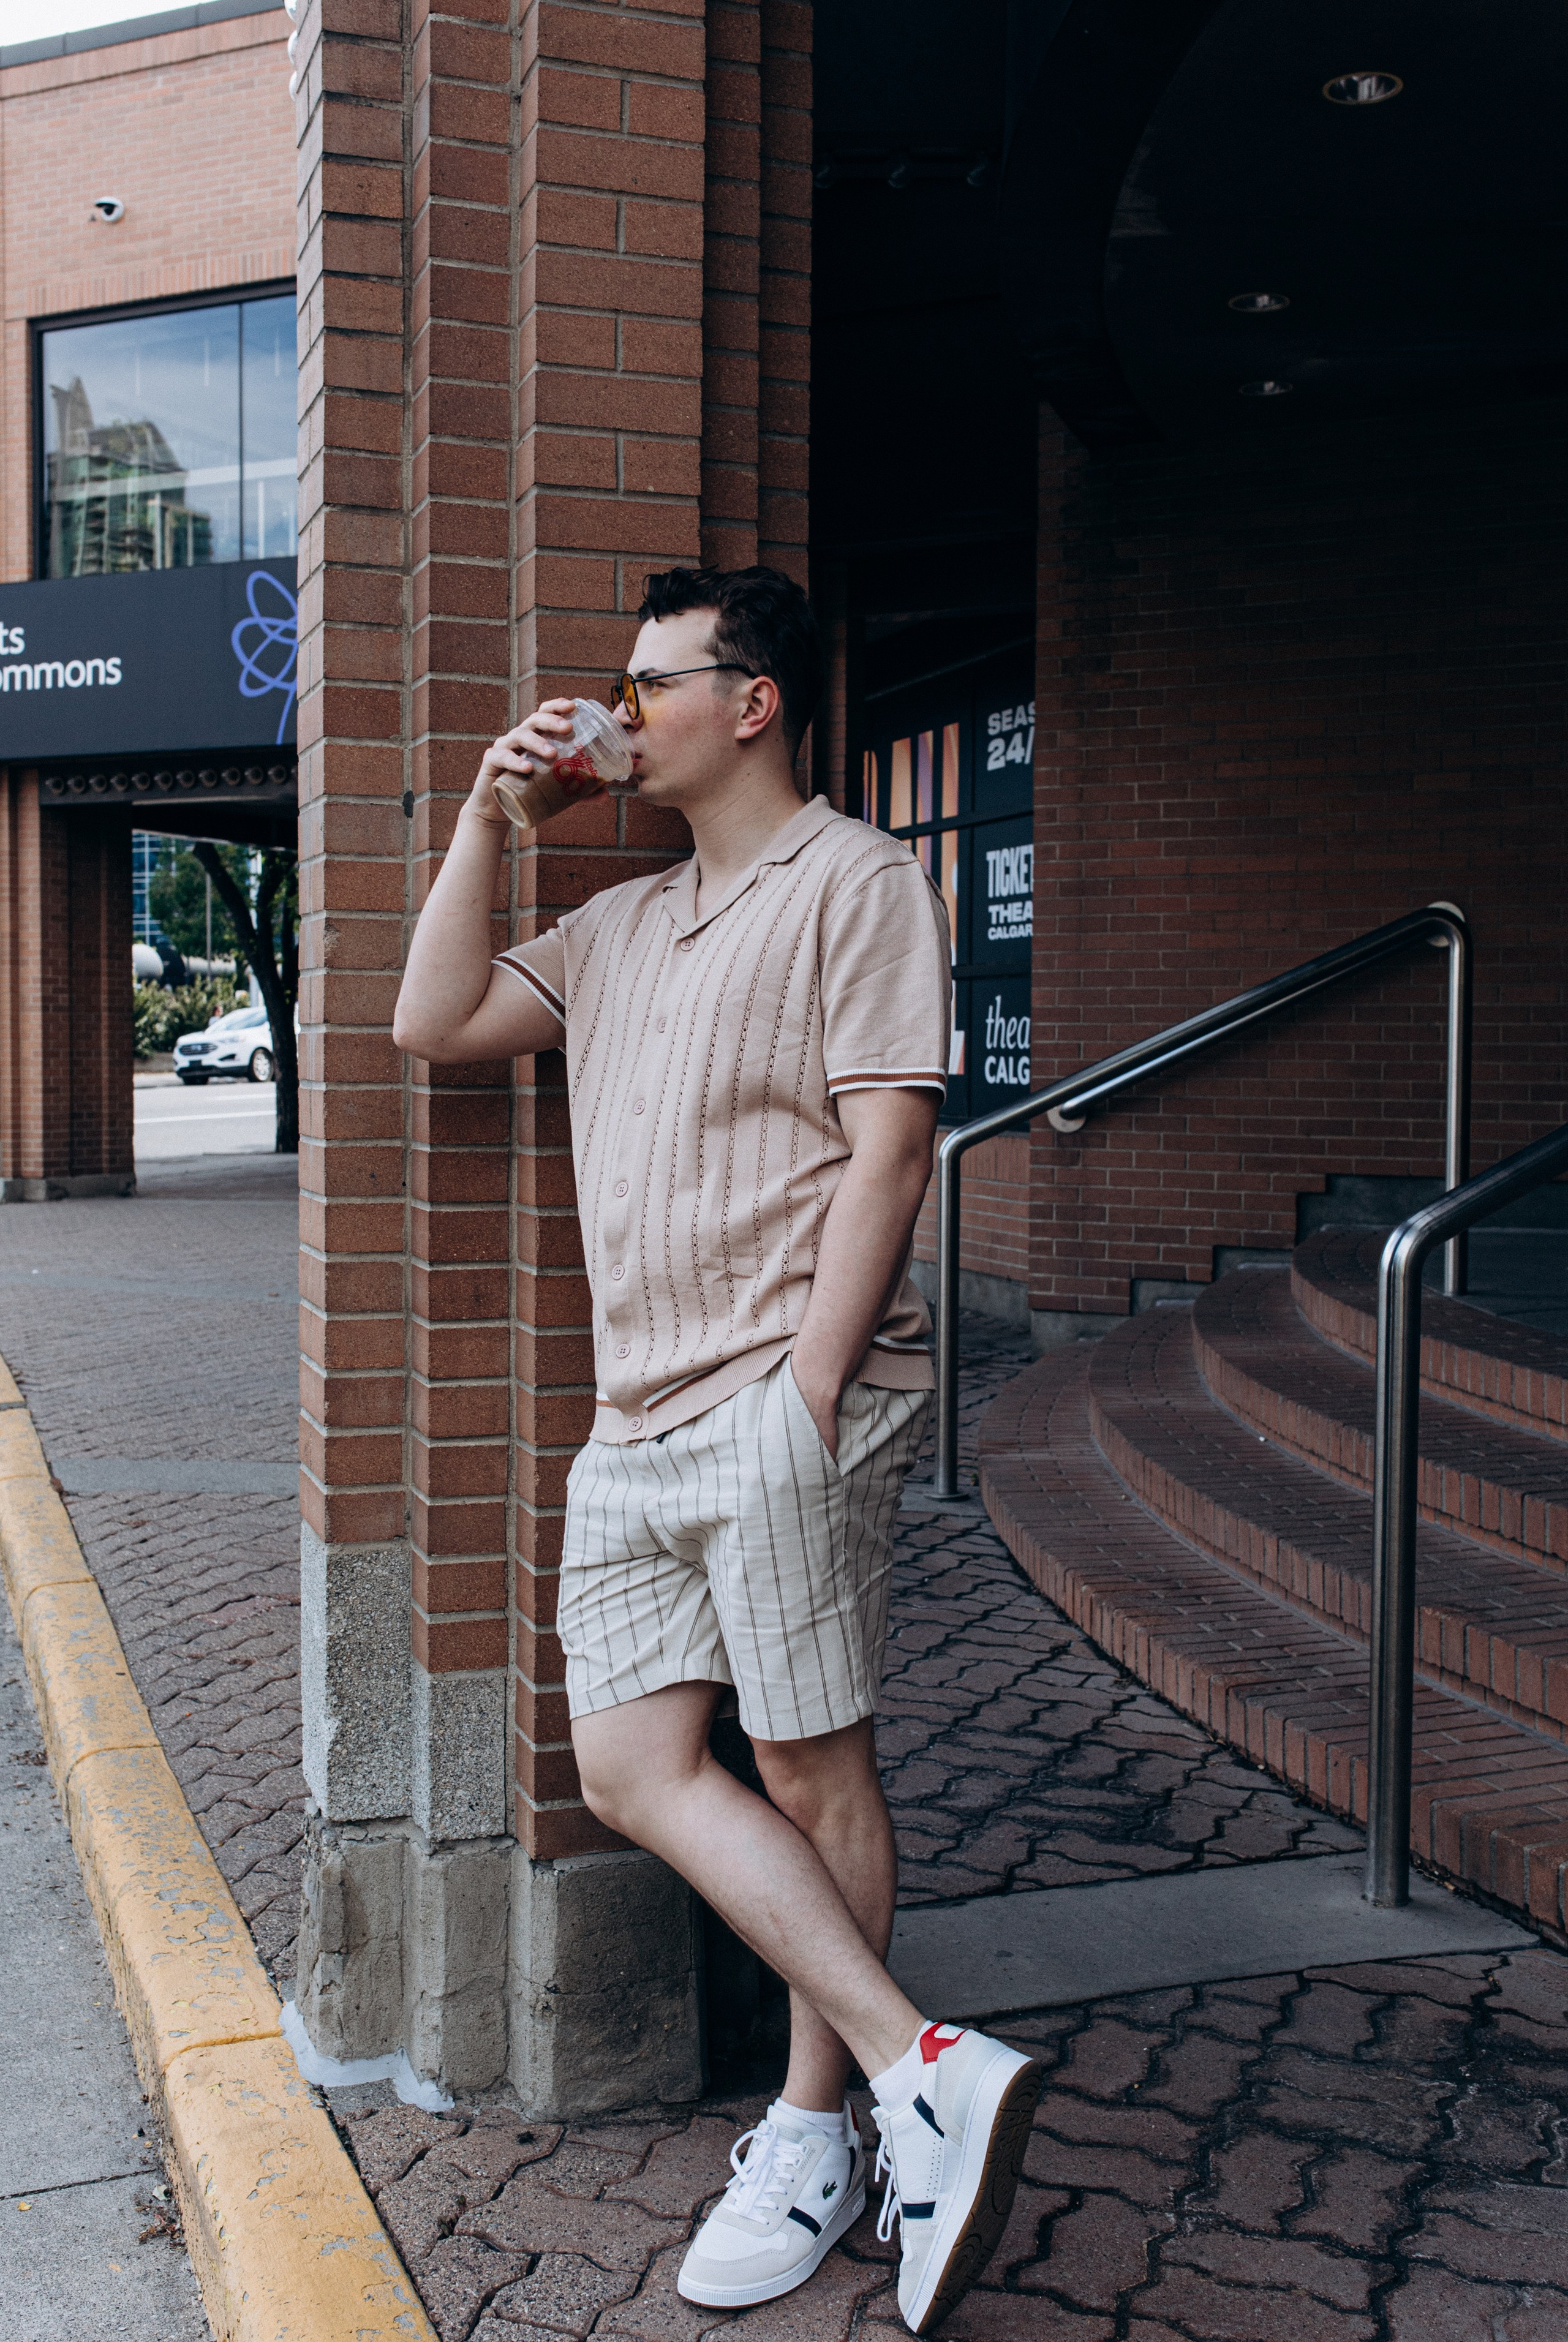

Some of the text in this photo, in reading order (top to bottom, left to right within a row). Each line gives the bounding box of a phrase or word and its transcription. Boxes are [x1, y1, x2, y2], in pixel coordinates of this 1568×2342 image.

[0, 657, 123, 693] mmons
[985, 994, 1031, 1049] thea
[984, 1055, 1030, 1086] CALG
